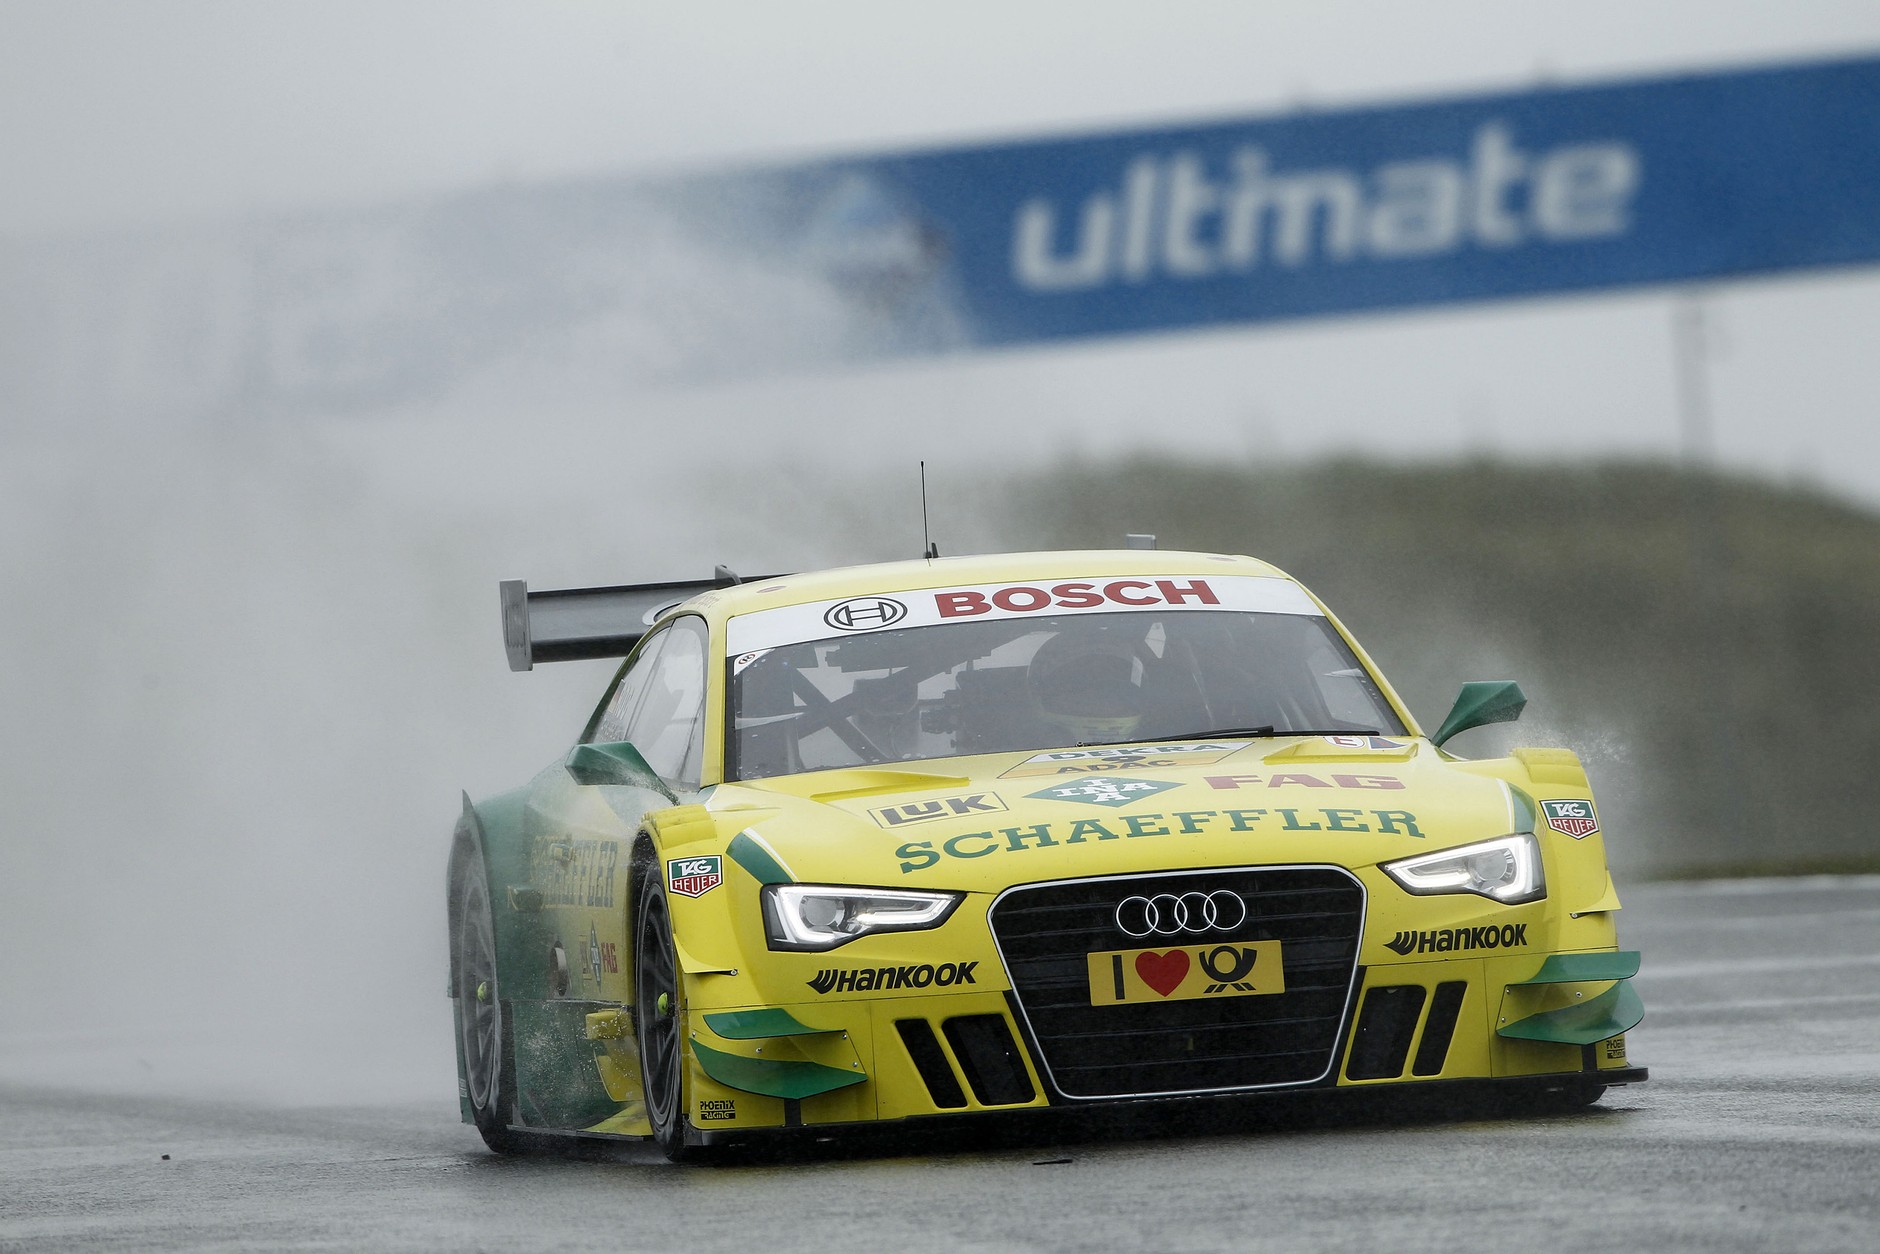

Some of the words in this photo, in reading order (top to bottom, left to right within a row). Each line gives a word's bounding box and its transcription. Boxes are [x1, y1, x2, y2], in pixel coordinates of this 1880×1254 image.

[1013, 120, 1640, 290] ultimate
[934, 580, 1221, 618] BOSCH
[1049, 744, 1230, 760] DEKRA
[1056, 759, 1177, 774] ADAC
[1203, 774, 1406, 790] FAG
[1552, 802, 1586, 817] TAG
[1553, 818, 1595, 836] HEUER
[895, 808, 1426, 874] SCHAEFFLER
[678, 859, 712, 876] TAG
[674, 875, 718, 894] HEUER
[1112, 954, 1125, 1000] I
